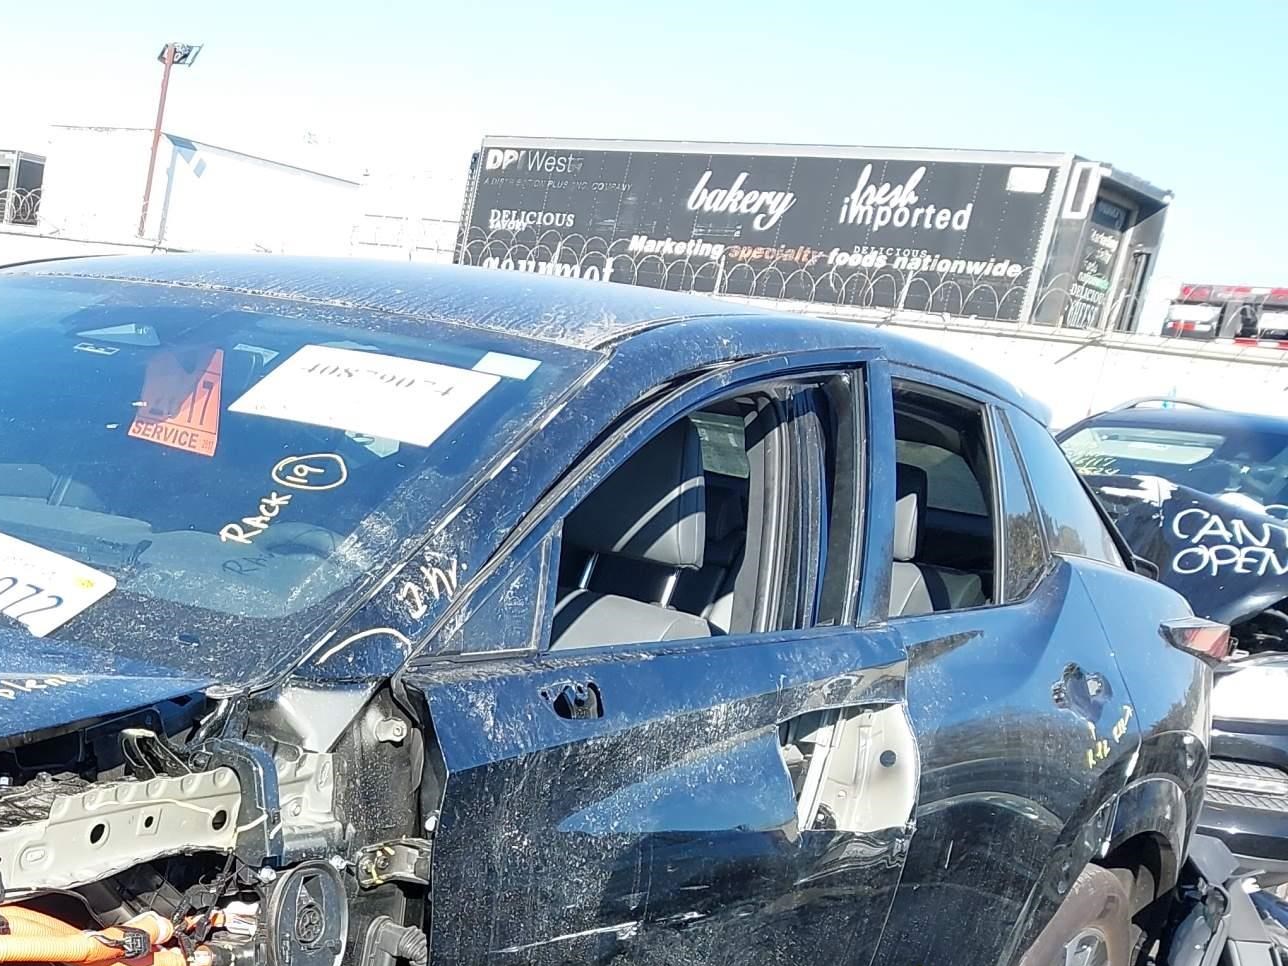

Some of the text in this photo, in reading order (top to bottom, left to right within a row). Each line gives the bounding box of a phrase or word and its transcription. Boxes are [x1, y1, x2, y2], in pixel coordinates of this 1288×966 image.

[528, 152, 574, 172] West
[851, 163, 926, 207] fresh
[686, 170, 798, 231] bakery
[839, 197, 974, 231] imported
[490, 209, 575, 227] DELICIOUS
[628, 235, 726, 261] Marketing
[828, 248, 888, 268] foods
[893, 254, 1023, 278] nationwide
[853, 246, 928, 258] DELICIOUS
[132, 420, 199, 449] SERVICE
[286, 464, 325, 483] 19
[1172, 545, 1288, 577] OPEN
